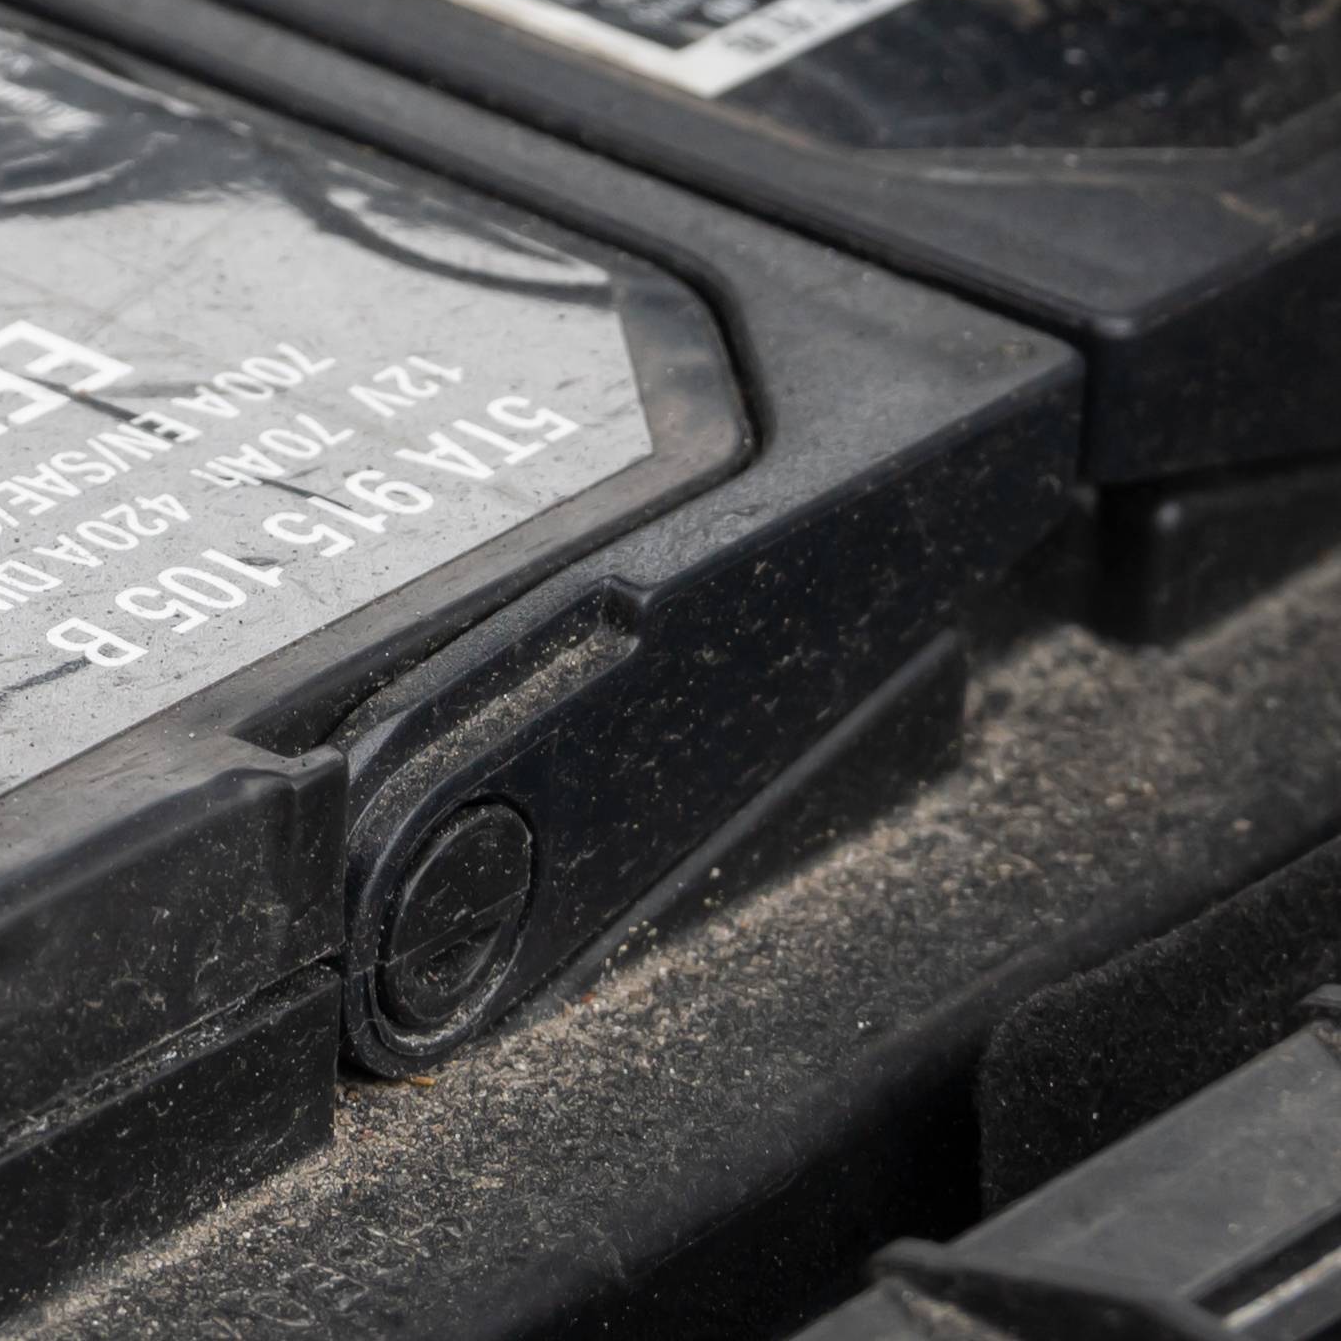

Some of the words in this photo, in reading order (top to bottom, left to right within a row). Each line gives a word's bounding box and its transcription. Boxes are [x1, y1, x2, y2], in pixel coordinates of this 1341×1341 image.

[170, 342, 337, 419] 700A
[348, 354, 465, 419] 12V
[190, 412, 357, 489] 70Ah
[394, 394, 581, 481] 5TA
[34, 492, 193, 571] 420A
[262, 468, 435, 557] 915
[115, 546, 286, 637] 105
[45, 617, 149, 668] B
